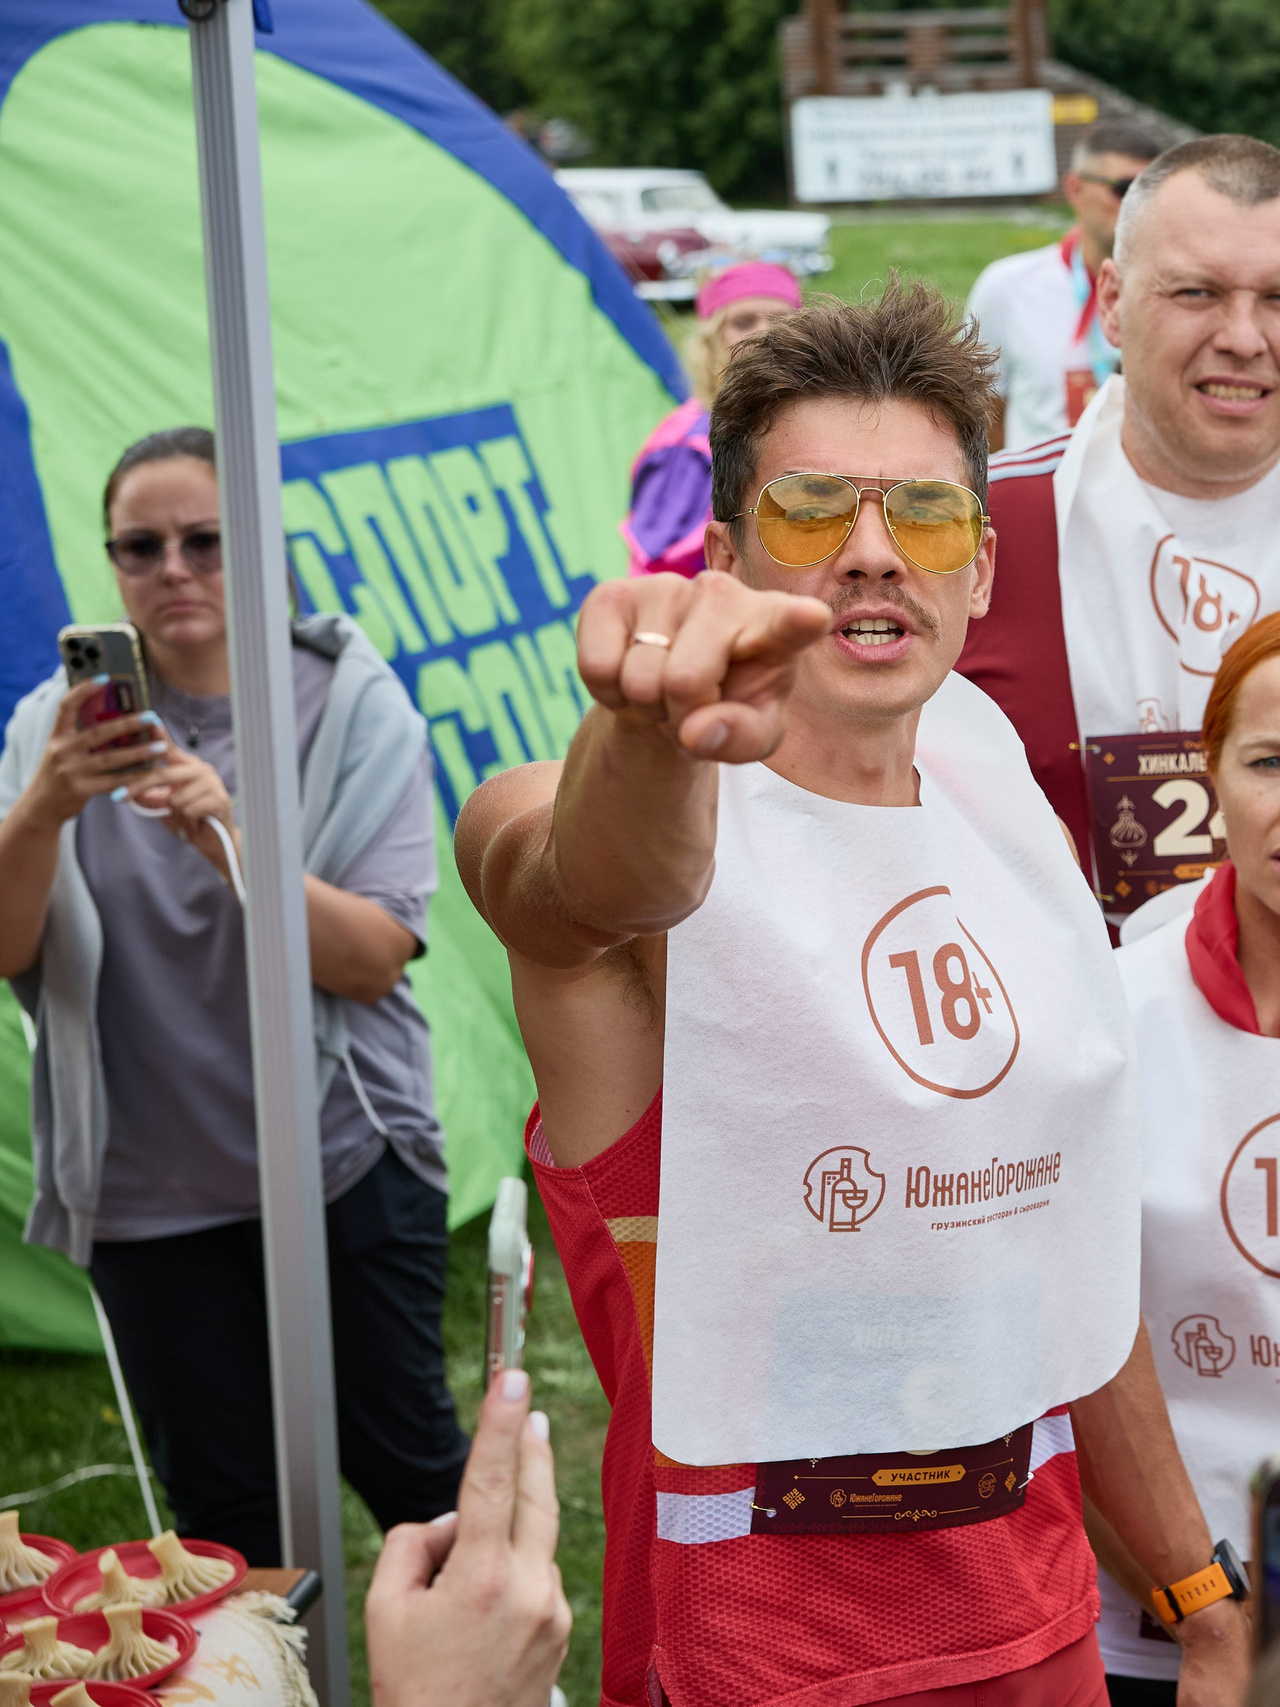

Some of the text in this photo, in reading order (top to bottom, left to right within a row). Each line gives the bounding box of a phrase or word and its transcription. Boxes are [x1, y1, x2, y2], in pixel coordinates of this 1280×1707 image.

[888, 942, 993, 1045] 18+
[931, 1215, 985, 1231] грузинский
[986, 1209, 1013, 1224] ресторан
[1019, 1199, 1050, 1213] сыроварня
[891, 1469, 951, 1482] УЧАСТНИК
